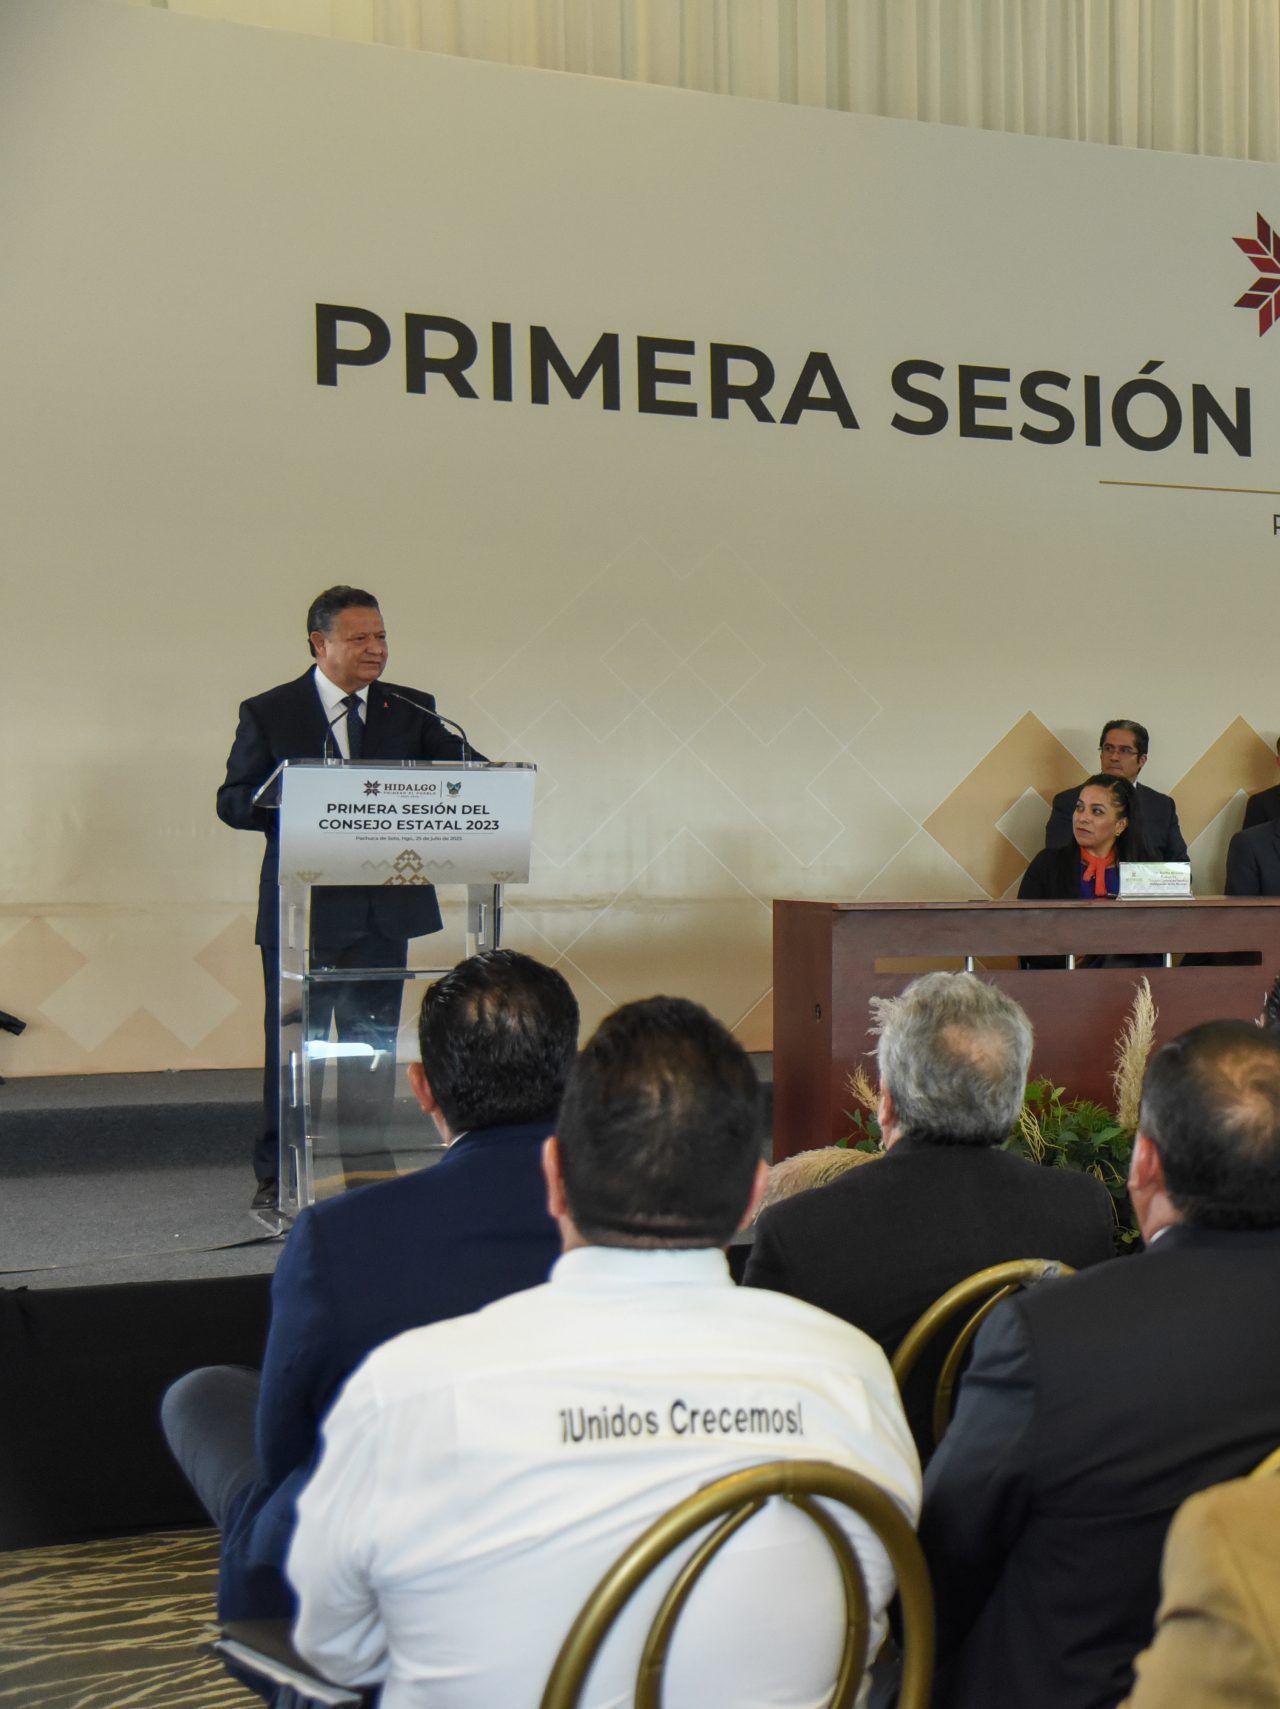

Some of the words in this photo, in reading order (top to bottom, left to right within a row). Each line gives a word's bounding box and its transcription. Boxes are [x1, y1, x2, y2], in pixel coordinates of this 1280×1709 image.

[315, 302, 861, 430] PRIMERA
[890, 359, 1252, 458] SESIÓN
[384, 783, 437, 791] HIDALGO
[327, 803, 398, 815] PRIMERA
[402, 802, 457, 815] SESIÓN
[462, 804, 490, 815] DEL
[318, 819, 392, 831] CONSEJO
[397, 819, 462, 831] ESTATAL
[466, 820, 499, 831] 2023
[559, 1404, 660, 1444] ¡Unidos
[669, 1398, 804, 1436] Crecemos!
